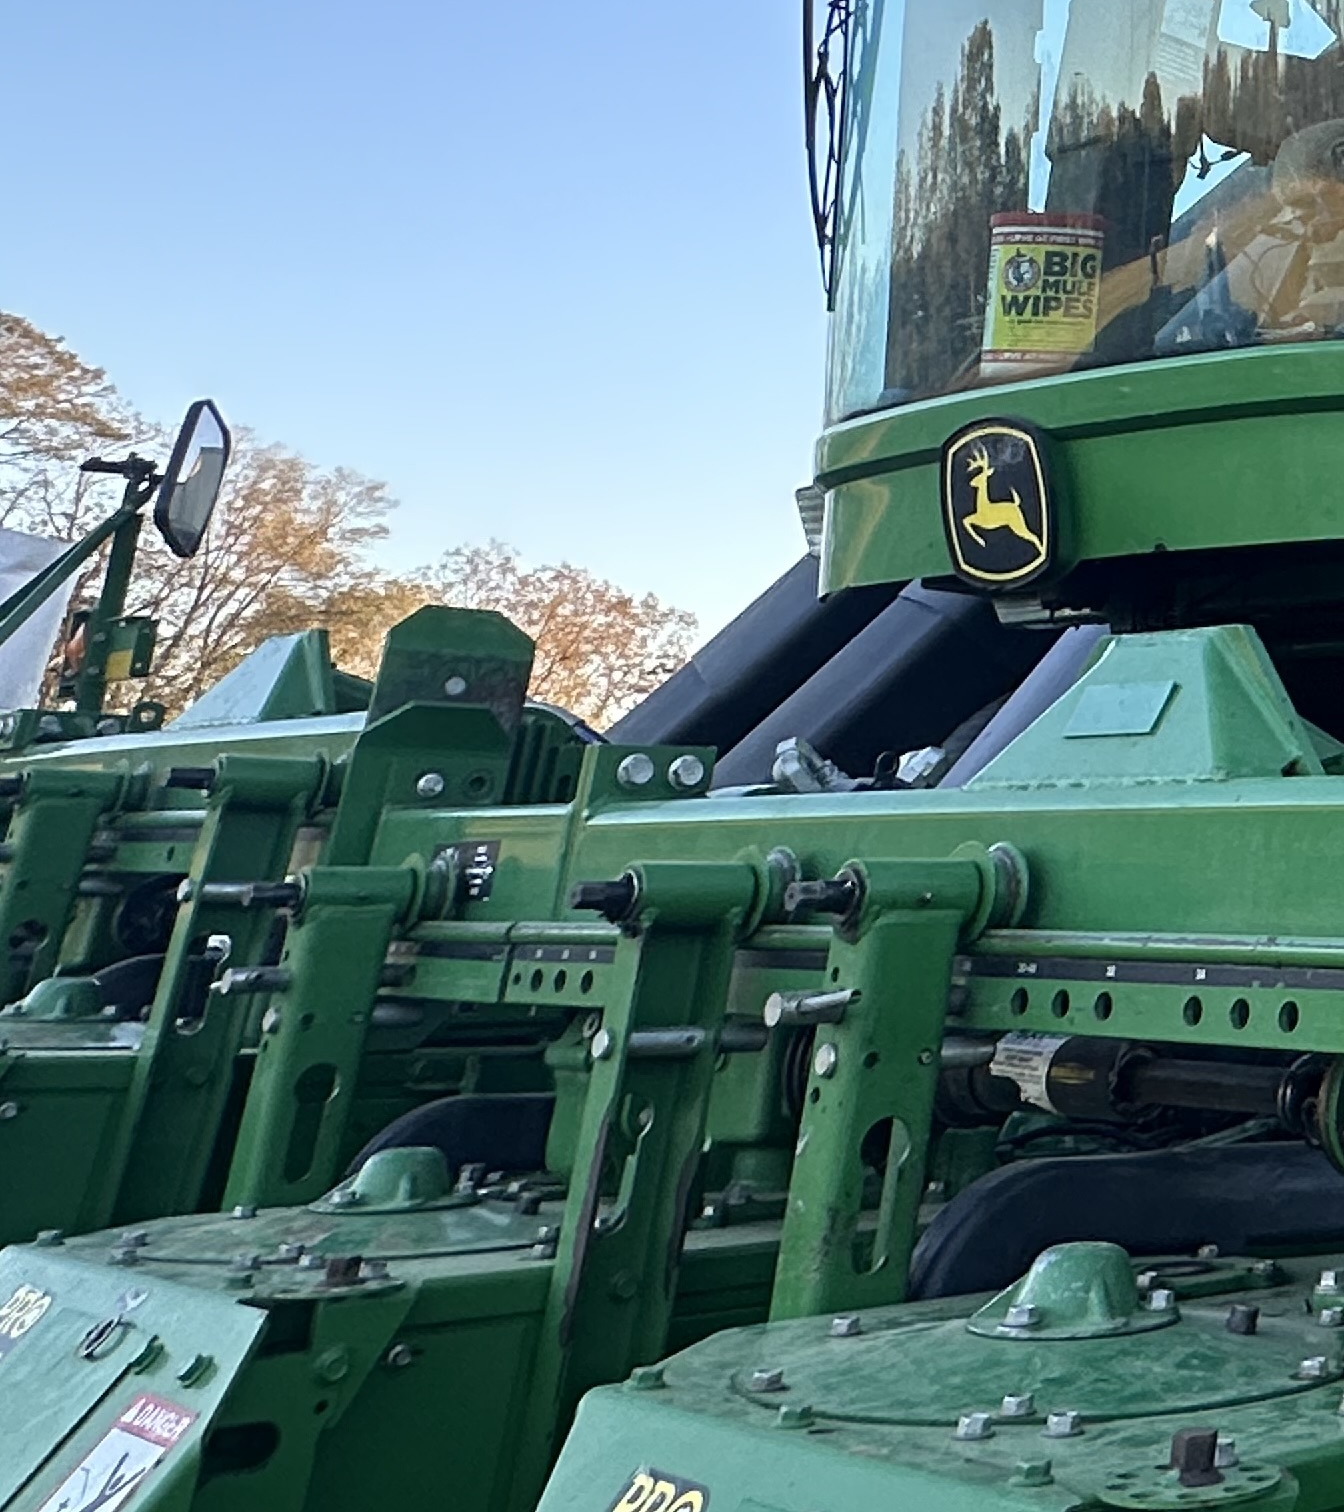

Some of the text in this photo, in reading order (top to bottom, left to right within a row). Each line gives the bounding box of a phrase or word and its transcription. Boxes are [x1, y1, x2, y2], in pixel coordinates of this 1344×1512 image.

[1043, 250, 1097, 279] BIG
[1042, 278, 1095, 297] MULE
[1001, 294, 1094, 319] WIPES
